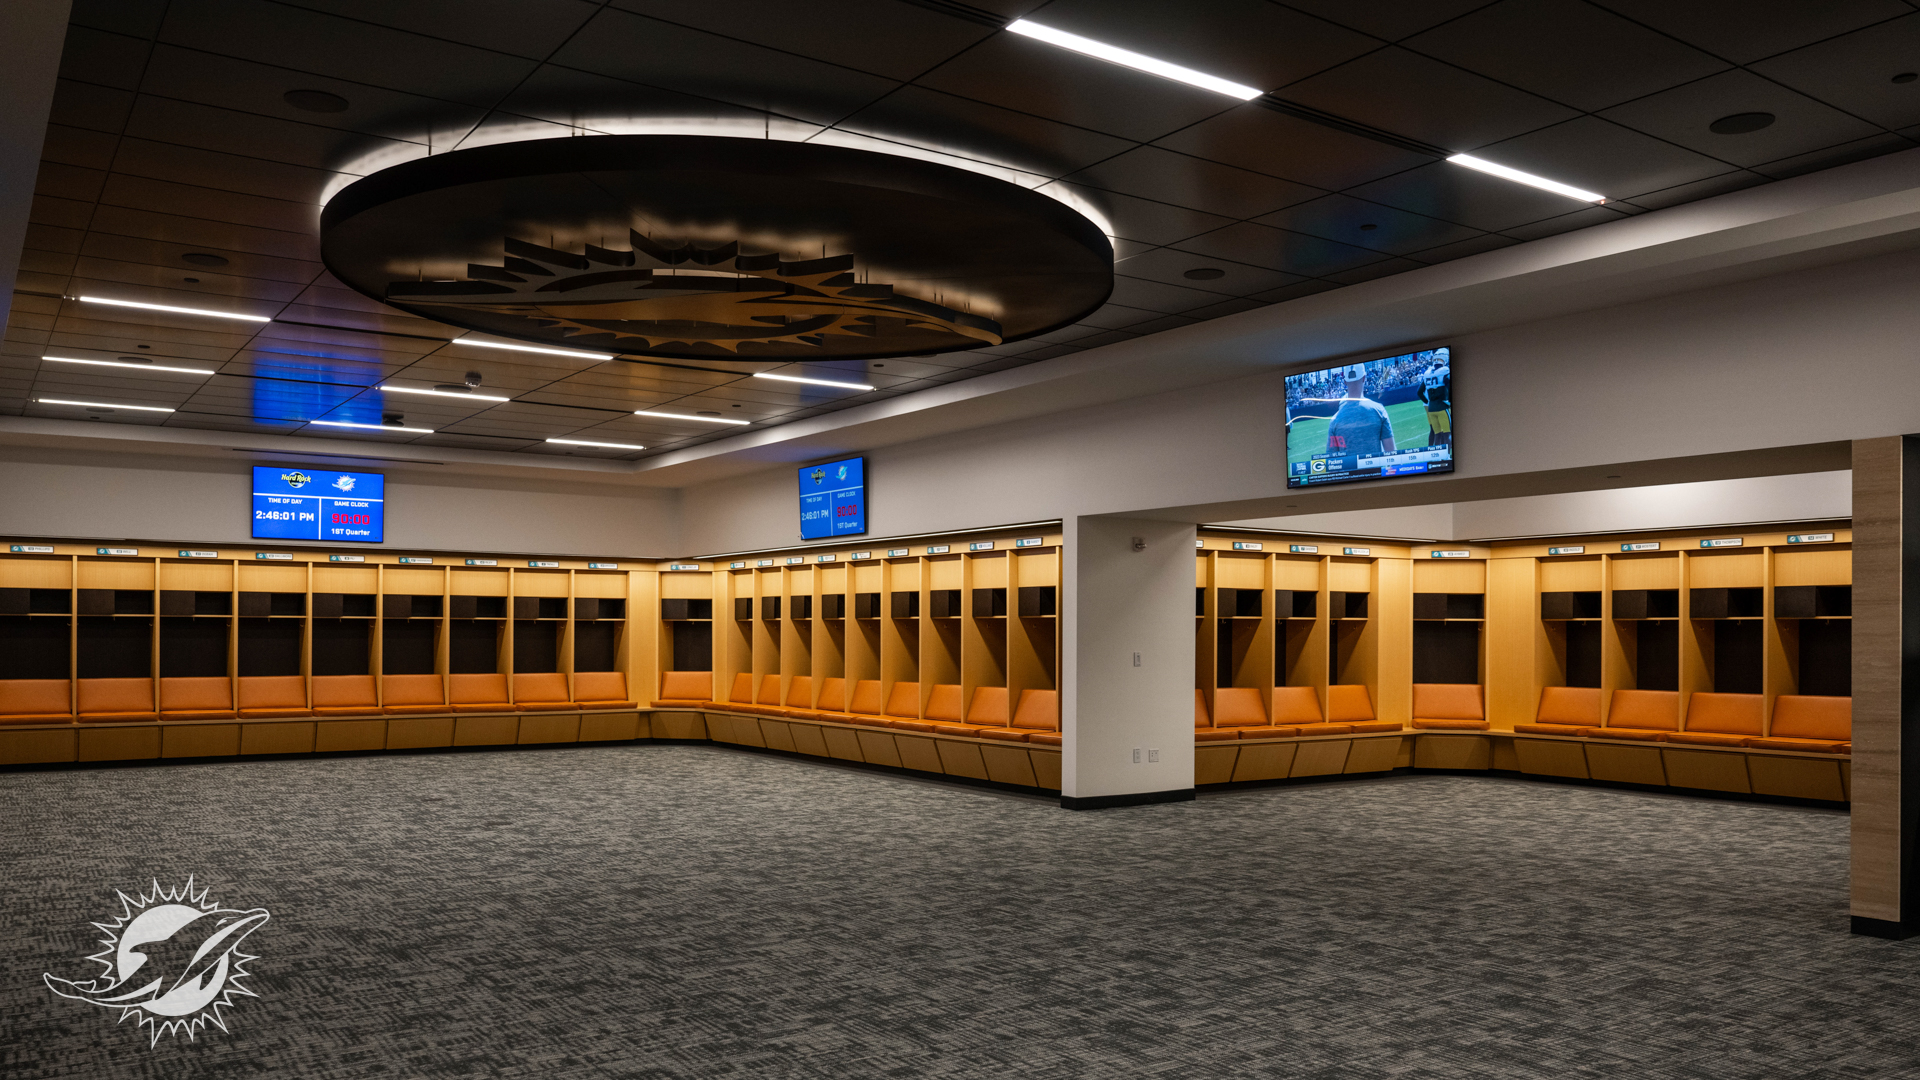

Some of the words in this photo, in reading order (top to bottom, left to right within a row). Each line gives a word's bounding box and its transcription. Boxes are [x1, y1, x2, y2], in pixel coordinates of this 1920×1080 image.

[297, 475, 311, 483] Rock
[256, 510, 295, 521] 2:46:01
[299, 512, 314, 521] PM
[801, 510, 820, 521] 2:46:01
[821, 509, 829, 518] PM
[837, 504, 857, 517] 90:00
[332, 513, 370, 525] 90:00
